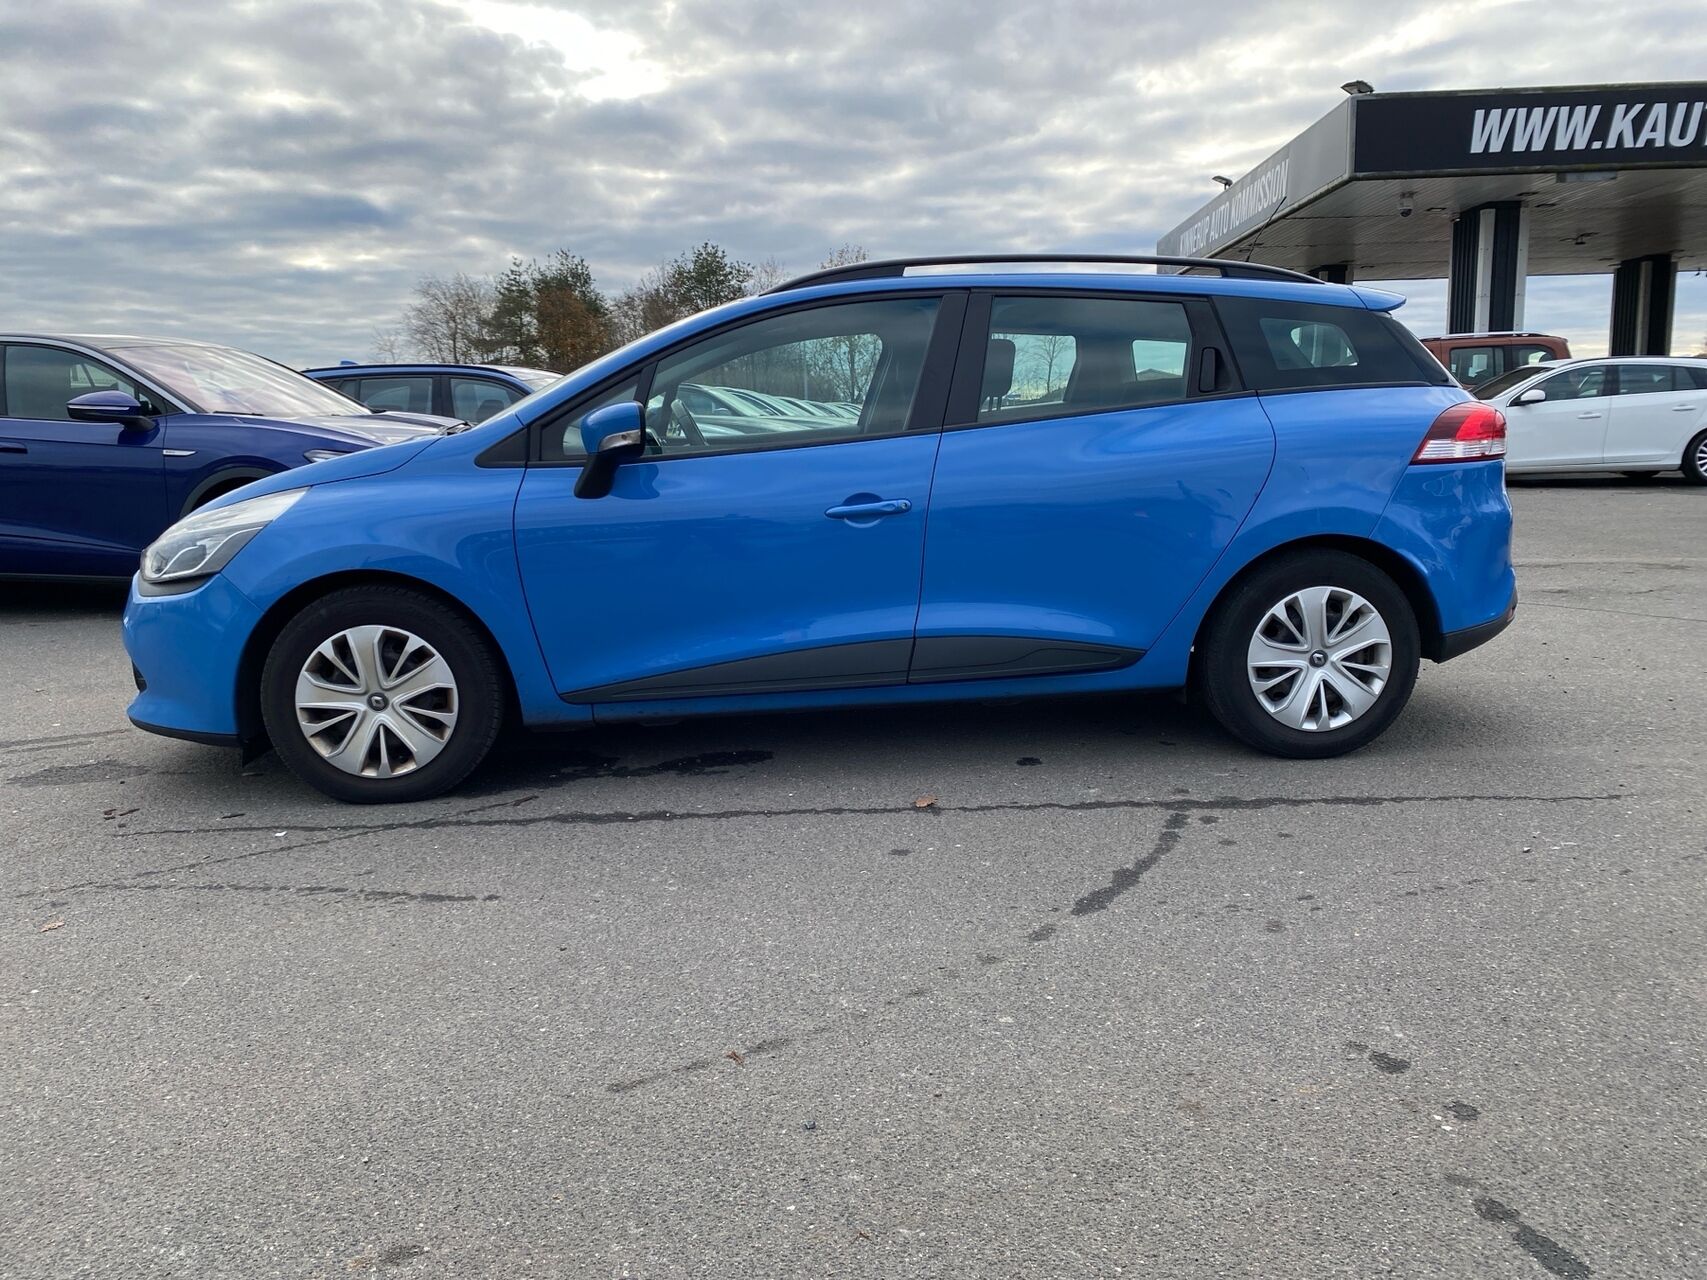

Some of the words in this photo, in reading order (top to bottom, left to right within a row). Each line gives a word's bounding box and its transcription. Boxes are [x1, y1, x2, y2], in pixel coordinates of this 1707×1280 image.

[1470, 101, 1707, 153] WWW.KAU
[1209, 201, 1230, 242] AUTO
[1230, 159, 1289, 230] KOMMISSION
